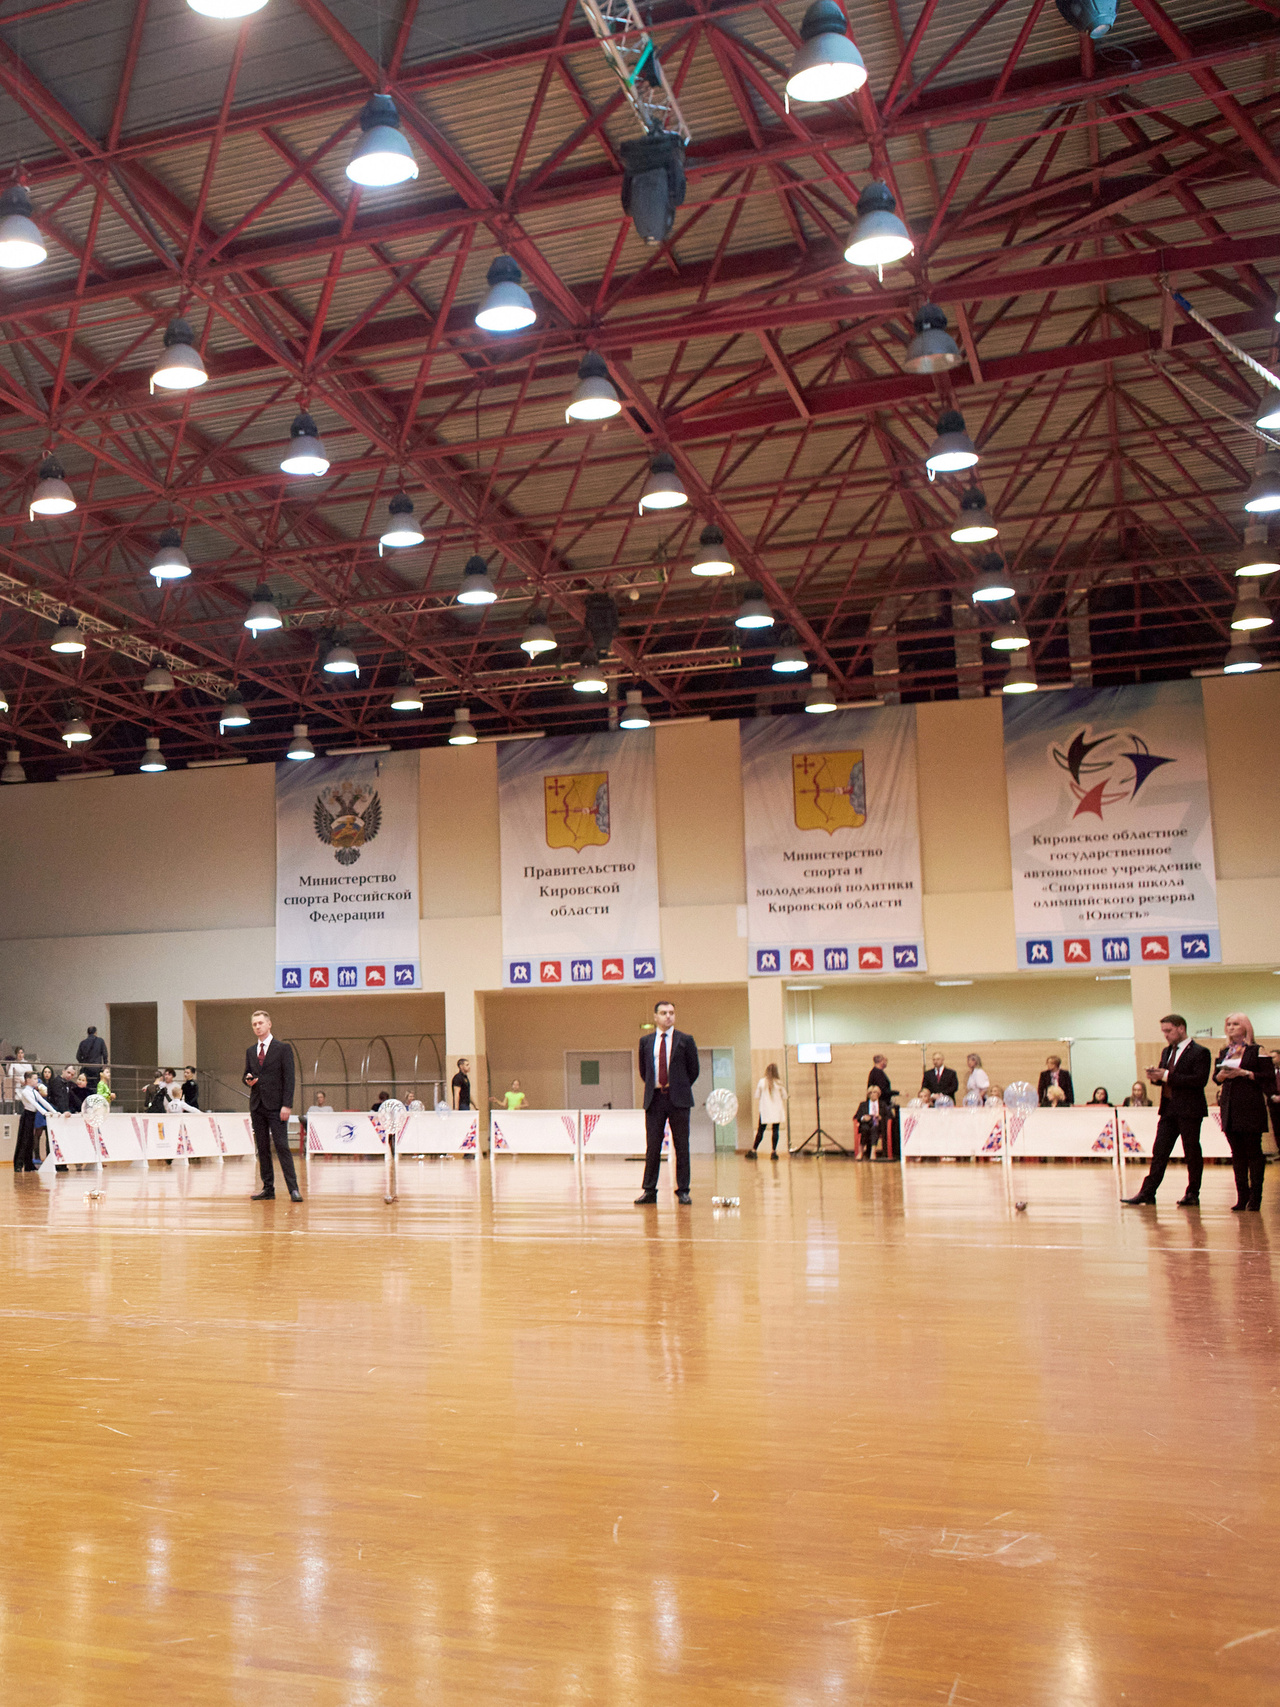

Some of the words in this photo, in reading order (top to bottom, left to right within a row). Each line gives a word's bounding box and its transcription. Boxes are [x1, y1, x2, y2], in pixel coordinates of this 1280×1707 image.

[1033, 832, 1109, 846] Кировское
[1113, 828, 1188, 841] областное
[783, 848, 883, 862] Министерство
[1050, 846, 1172, 863] государственное
[524, 863, 636, 880] Правительство
[803, 867, 851, 878] спорта
[854, 866, 863, 875] и
[1024, 866, 1108, 879] автономное
[1112, 862, 1202, 876] учреждение
[299, 874, 397, 886] Министерство
[1042, 880, 1134, 893] «Спортивная
[1138, 878, 1185, 889] школа
[539, 882, 620, 899] Кировской
[756, 883, 842, 897] молодежной
[846, 881, 914, 893] политики
[284, 895, 329, 907] спорта
[333, 889, 412, 903] Российской
[1033, 893, 1135, 908] олимпийского
[1138, 892, 1195, 906] резерва
[550, 905, 609, 917] области
[768, 901, 842, 914] Кировской
[846, 899, 902, 910] области
[309, 911, 385, 923] Федерации
[1078, 910, 1150, 921] «Юность»
